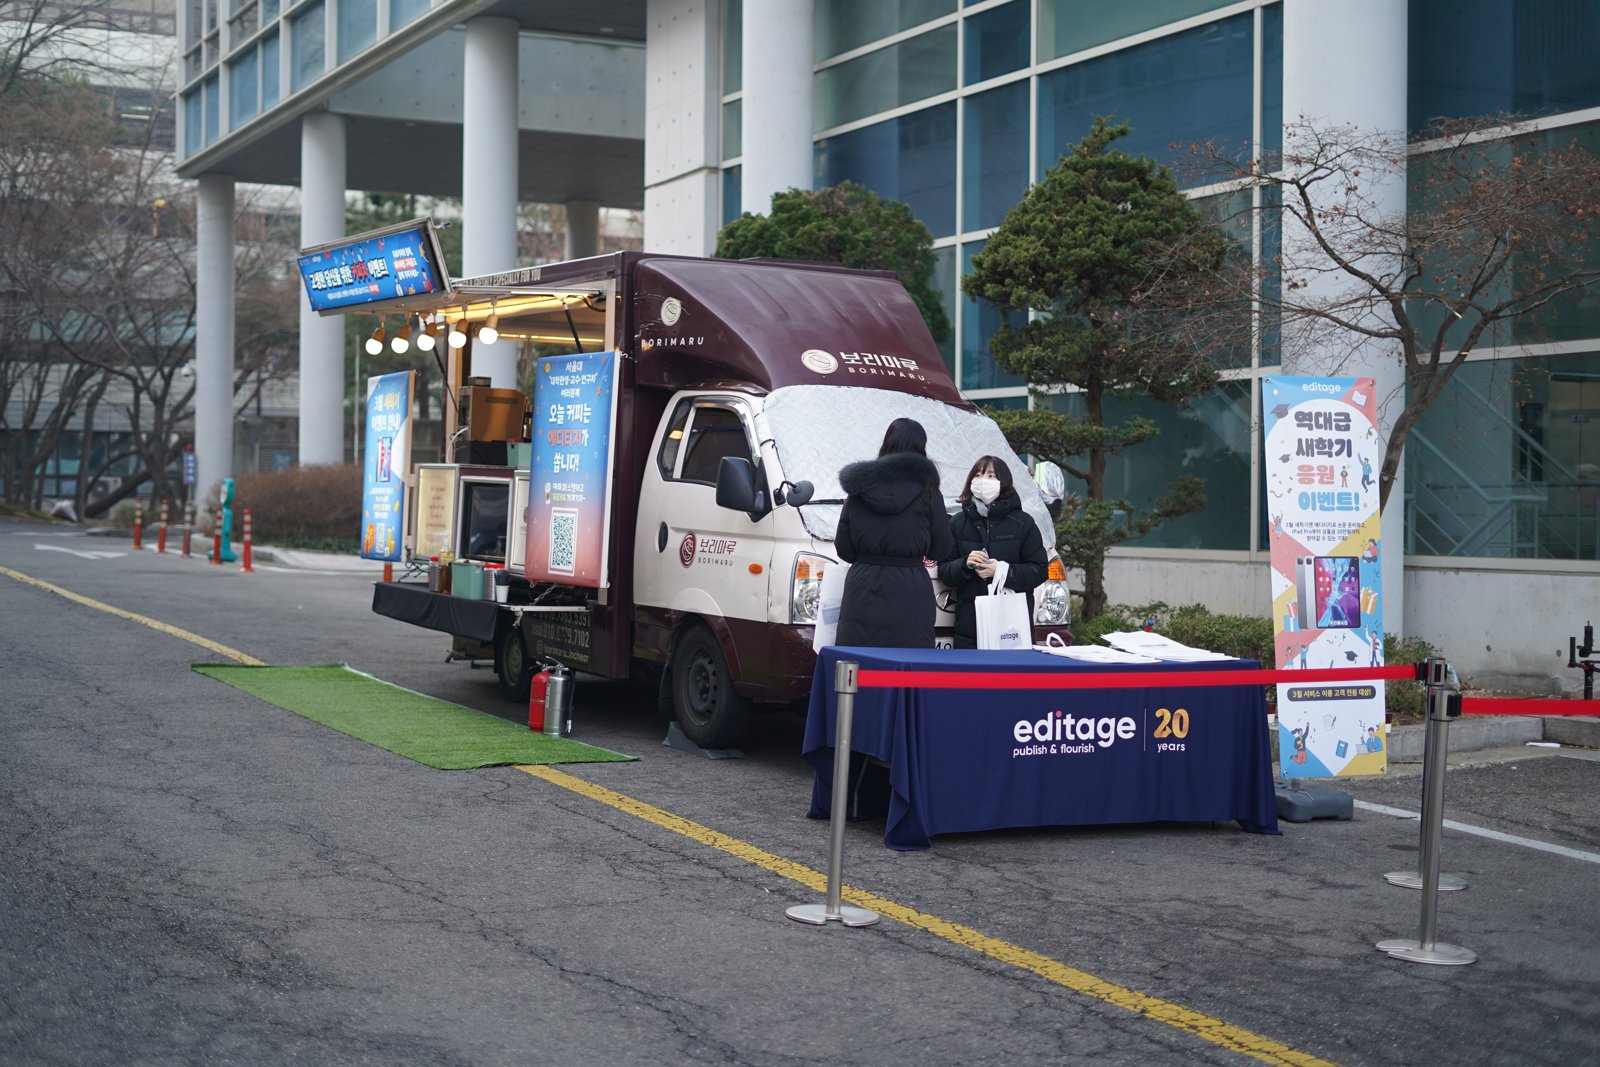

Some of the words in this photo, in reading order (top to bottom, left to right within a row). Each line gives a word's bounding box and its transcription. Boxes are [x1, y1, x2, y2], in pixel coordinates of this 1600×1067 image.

[521, 269, 530, 283] FOR
[531, 268, 541, 281] YOU
[641, 336, 705, 347] BORIMARU
[566, 360, 583, 373] 서울대
[839, 351, 920, 371] 보리마루
[848, 367, 926, 382] BORIMARU
[1302, 381, 1341, 394] editage
[549, 404, 565, 425] 오늘
[566, 403, 592, 424] 커피는
[1294, 411, 1351, 432] 역대급
[548, 429, 589, 447] 에디티지가
[1295, 437, 1352, 458] 새학기
[553, 452, 580, 473] 쏩니다!
[1296, 464, 1335, 485] 응원
[1298, 491, 1360, 512] 이벤트!
[699, 538, 737, 555] 보리마루
[698, 556, 734, 567] BORIMARU
[1292, 689, 1302, 698] 3월
[1304, 689, 1320, 698] 서비스
[1321, 689, 1333, 698] 이용
[1334, 688, 1345, 697] 고객
[1346, 688, 1357, 697] 전원
[1013, 710, 1136, 748] editage
[1153, 708, 1190, 739] 20
[1012, 745, 1048, 759] publish
[1049, 744, 1057, 754] &
[1060, 743, 1095, 754] flourish
[1157, 742, 1186, 754] years
